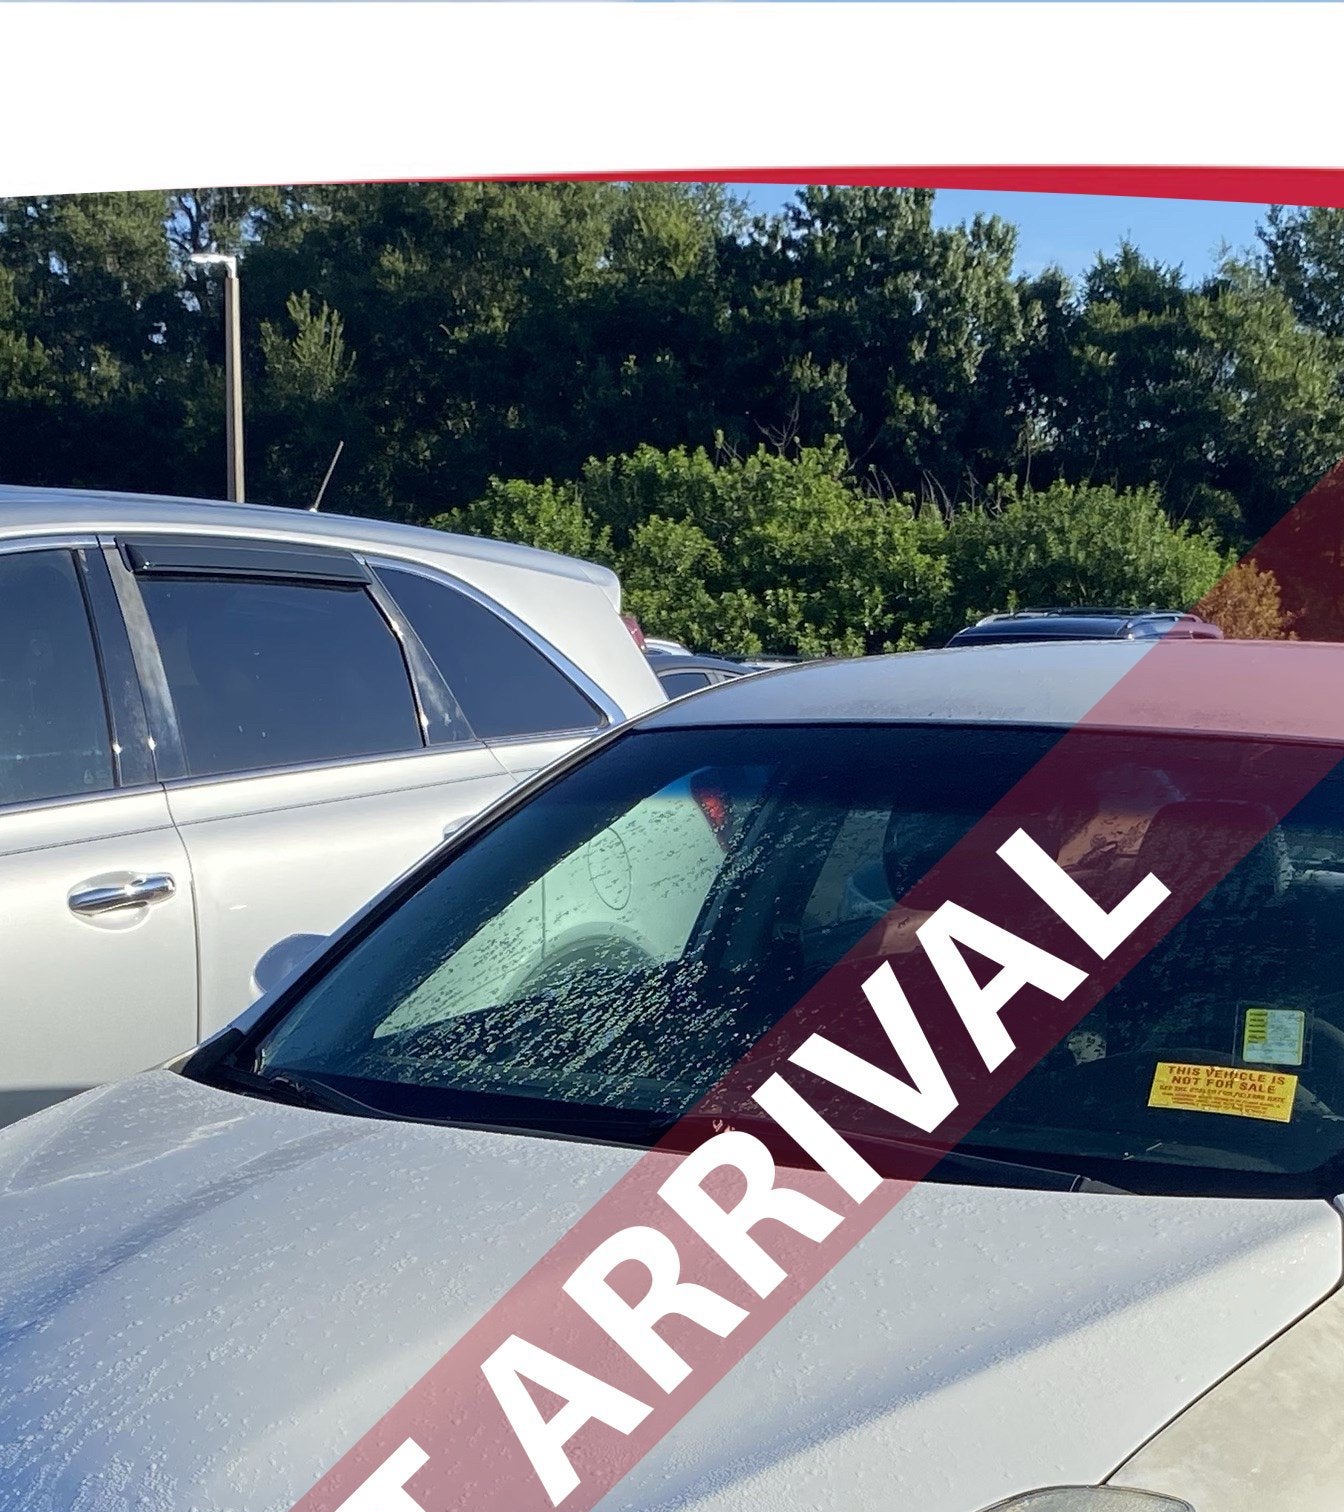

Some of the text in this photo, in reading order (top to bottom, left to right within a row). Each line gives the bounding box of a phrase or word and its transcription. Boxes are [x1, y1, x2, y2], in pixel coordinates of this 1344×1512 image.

[1168, 1065, 1286, 1085] THIS VEHICLE IS
[1171, 1075, 1201, 1085] NOT
[1206, 1078, 1234, 1089] FOR
[1239, 1081, 1276, 1094] SALE
